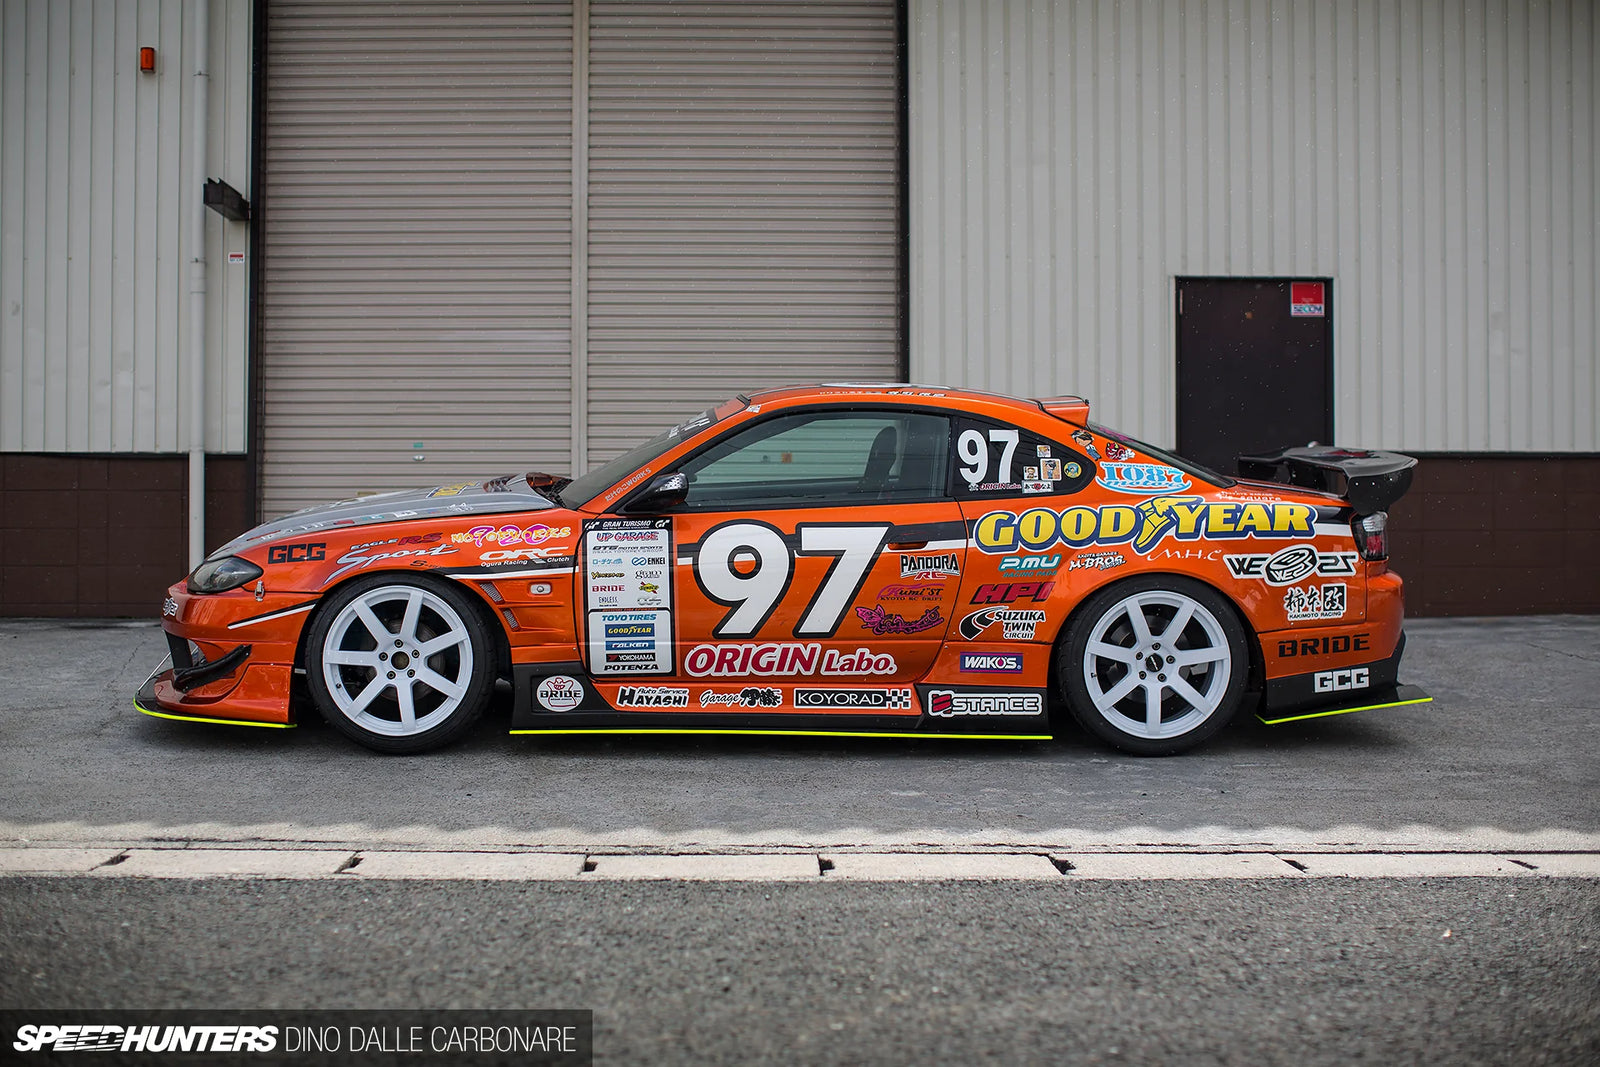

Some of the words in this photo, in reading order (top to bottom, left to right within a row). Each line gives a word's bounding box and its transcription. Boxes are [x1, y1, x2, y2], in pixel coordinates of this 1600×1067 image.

[957, 429, 1019, 484] 97
[1103, 466, 1185, 483] 1087
[976, 498, 1314, 553] GOODYEAR
[350, 538, 399, 550] EAGLE
[398, 532, 443, 545] RS
[597, 532, 614, 542] UP
[614, 531, 659, 541] GARAGE
[268, 543, 326, 564] GCG
[479, 546, 569, 563] ORC
[647, 557, 665, 565] ENKEI
[324, 544, 459, 585] Sport
[480, 560, 502, 568] Ogura
[900, 554, 959, 572] PANDORA
[1000, 555, 1060, 570] P.MU
[695, 521, 892, 637] 97
[915, 571, 947, 580] RC
[970, 582, 1055, 604] HPI
[994, 611, 1045, 622] SUZUKA
[608, 626, 652, 634] GOODYEAR
[1003, 622, 1036, 632] TWIN
[1278, 633, 1370, 657] BRIDE
[686, 645, 819, 674] ORIGIN
[822, 650, 896, 673] Labo.
[1314, 667, 1370, 693] GCG
[540, 690, 581, 698] BRIDE
[618, 687, 688, 707] HAYASHI
[638, 687, 658, 695] Auto
[658, 687, 688, 695] Service
[699, 689, 740, 708] Garage
[798, 692, 884, 705] KOYORAD
